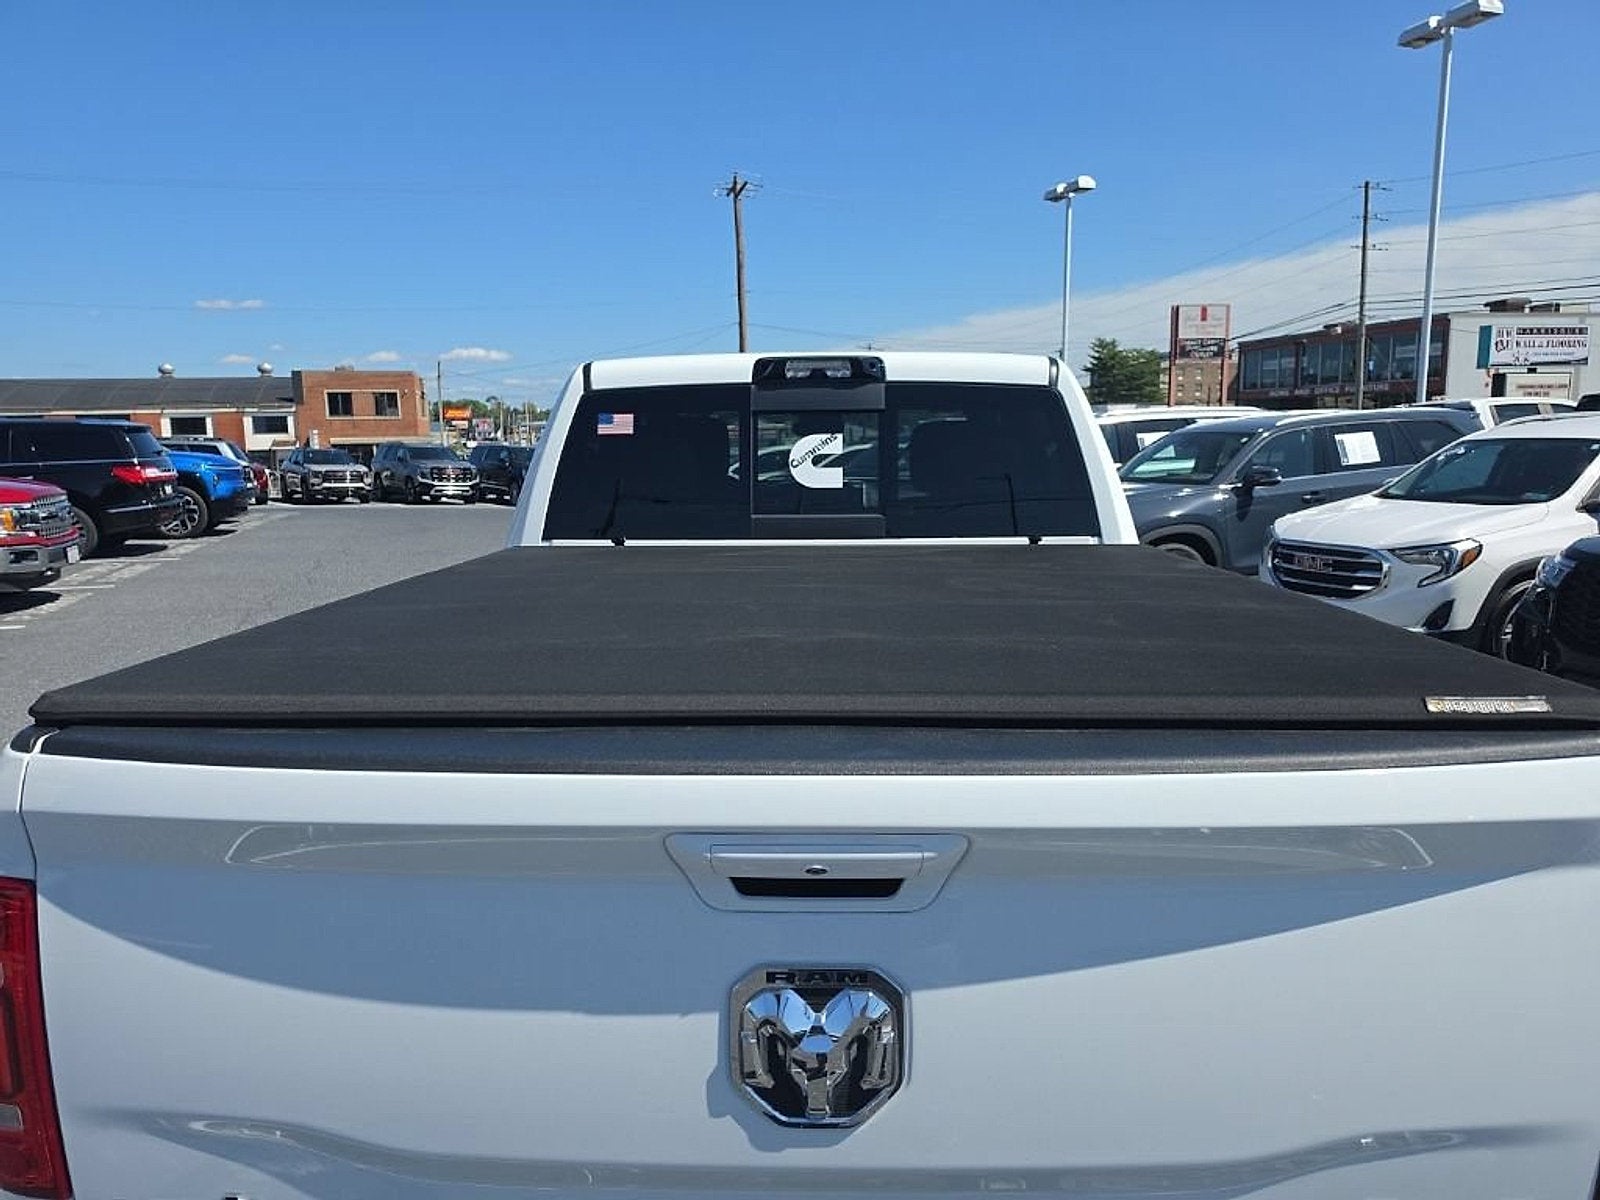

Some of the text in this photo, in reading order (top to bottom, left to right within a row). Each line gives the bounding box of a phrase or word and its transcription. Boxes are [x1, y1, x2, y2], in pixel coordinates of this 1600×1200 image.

[1515, 339, 1536, 348] WALL
[1546, 339, 1588, 348] FLOORING
[790, 434, 838, 469] Cummins
[765, 971, 869, 985] RAM
